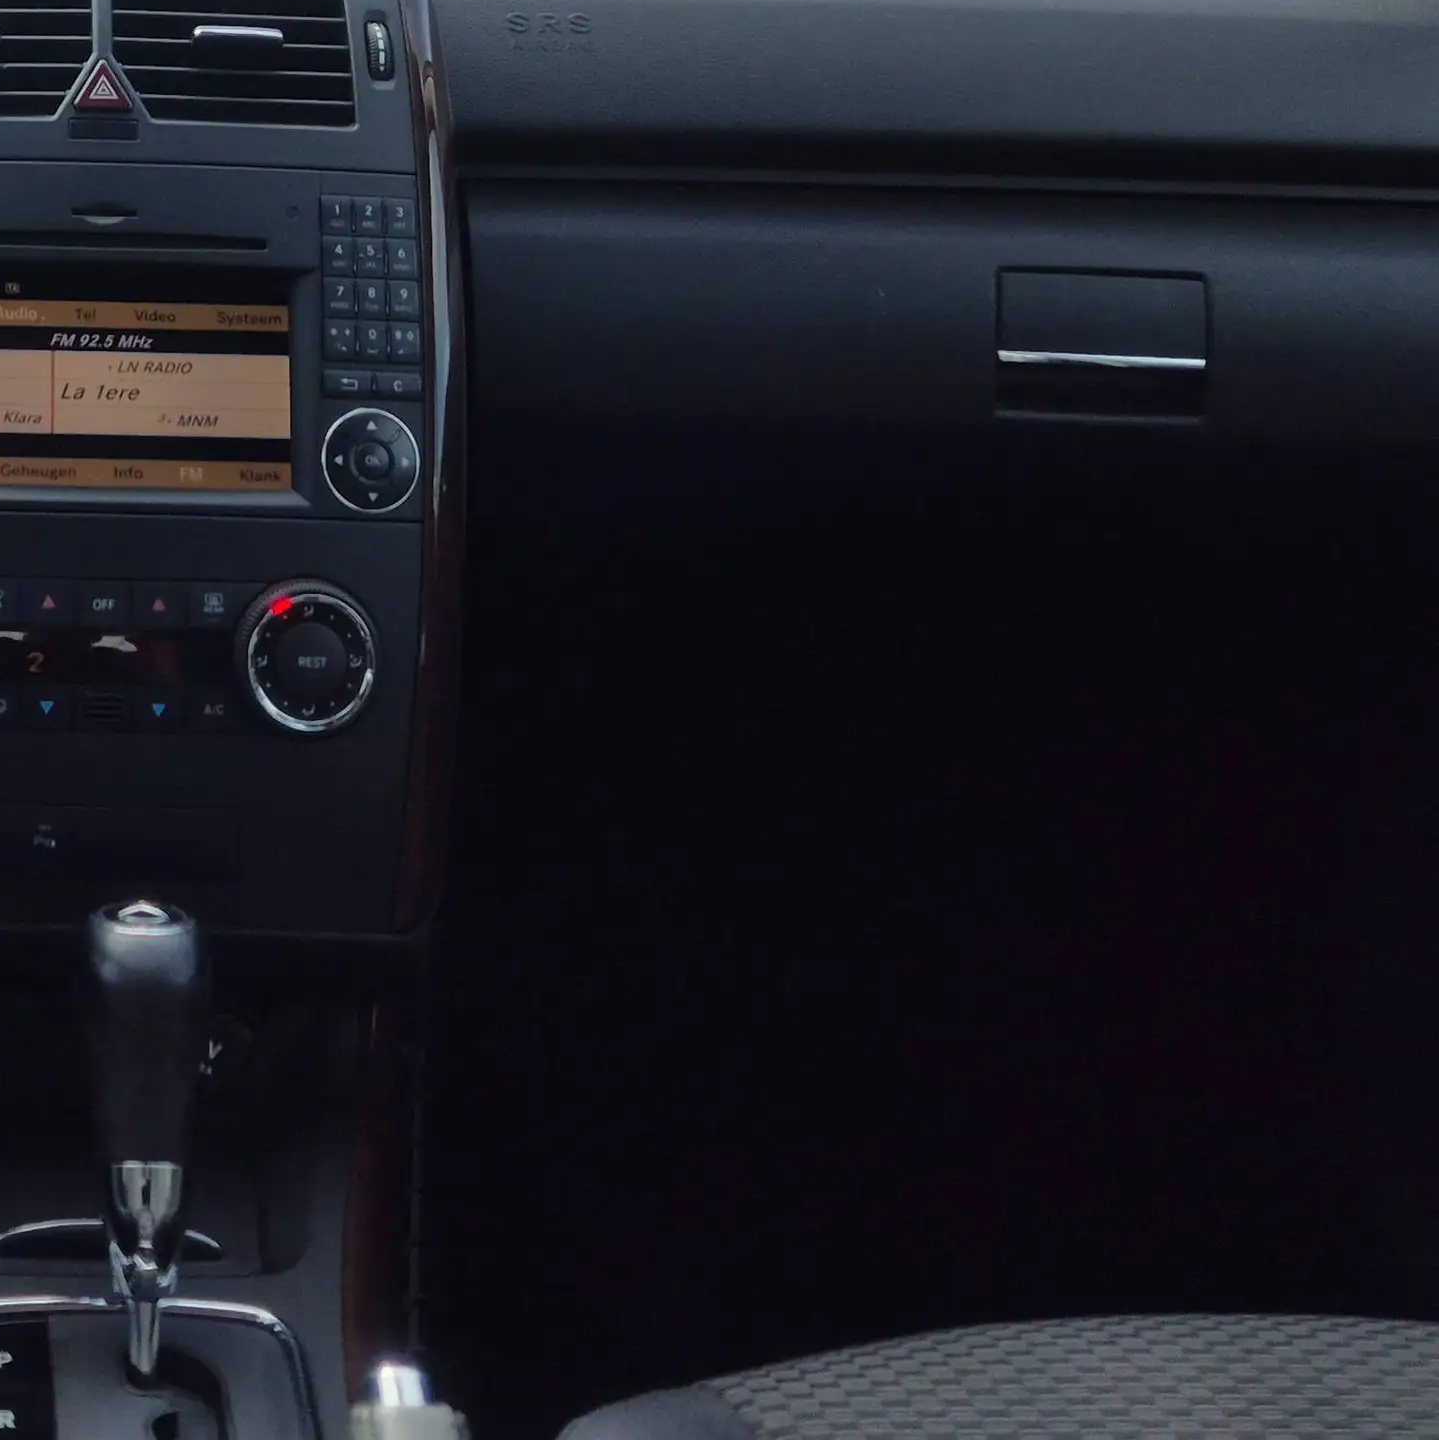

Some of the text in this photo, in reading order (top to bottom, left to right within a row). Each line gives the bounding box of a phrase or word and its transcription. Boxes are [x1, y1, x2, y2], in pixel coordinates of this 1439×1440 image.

[506, 11, 592, 34] SRS
[334, 204, 340, 216] 1
[364, 204, 373, 216] 2
[396, 206, 404, 218] 3
[334, 243, 343, 255] 4
[366, 245, 375, 256] 5
[397, 247, 406, 259] 6
[336, 285, 345, 297] 7
[367, 286, 376, 298] 8
[399, 288, 409, 300] 9
[74, 307, 97, 321] Tel
[134, 309, 177, 323] Video
[216, 311, 282, 327] Systeem
[50, 332, 154, 349] FM 92.5 MHz
[117, 360, 194, 374] LN RADIO
[60, 382, 86, 400] La
[393, 380, 403, 392] C
[2, 410, 43, 424] Klara
[177, 414, 219, 428] MNM
[0, 463, 77, 481] Geheugen
[113, 465, 144, 480] Info
[179, 466, 203, 482] FM
[239, 468, 281, 482] Klank
[92, 598, 116, 611] OFF
[298, 656, 327, 669] REST
[203, 704, 225, 716] A/C
